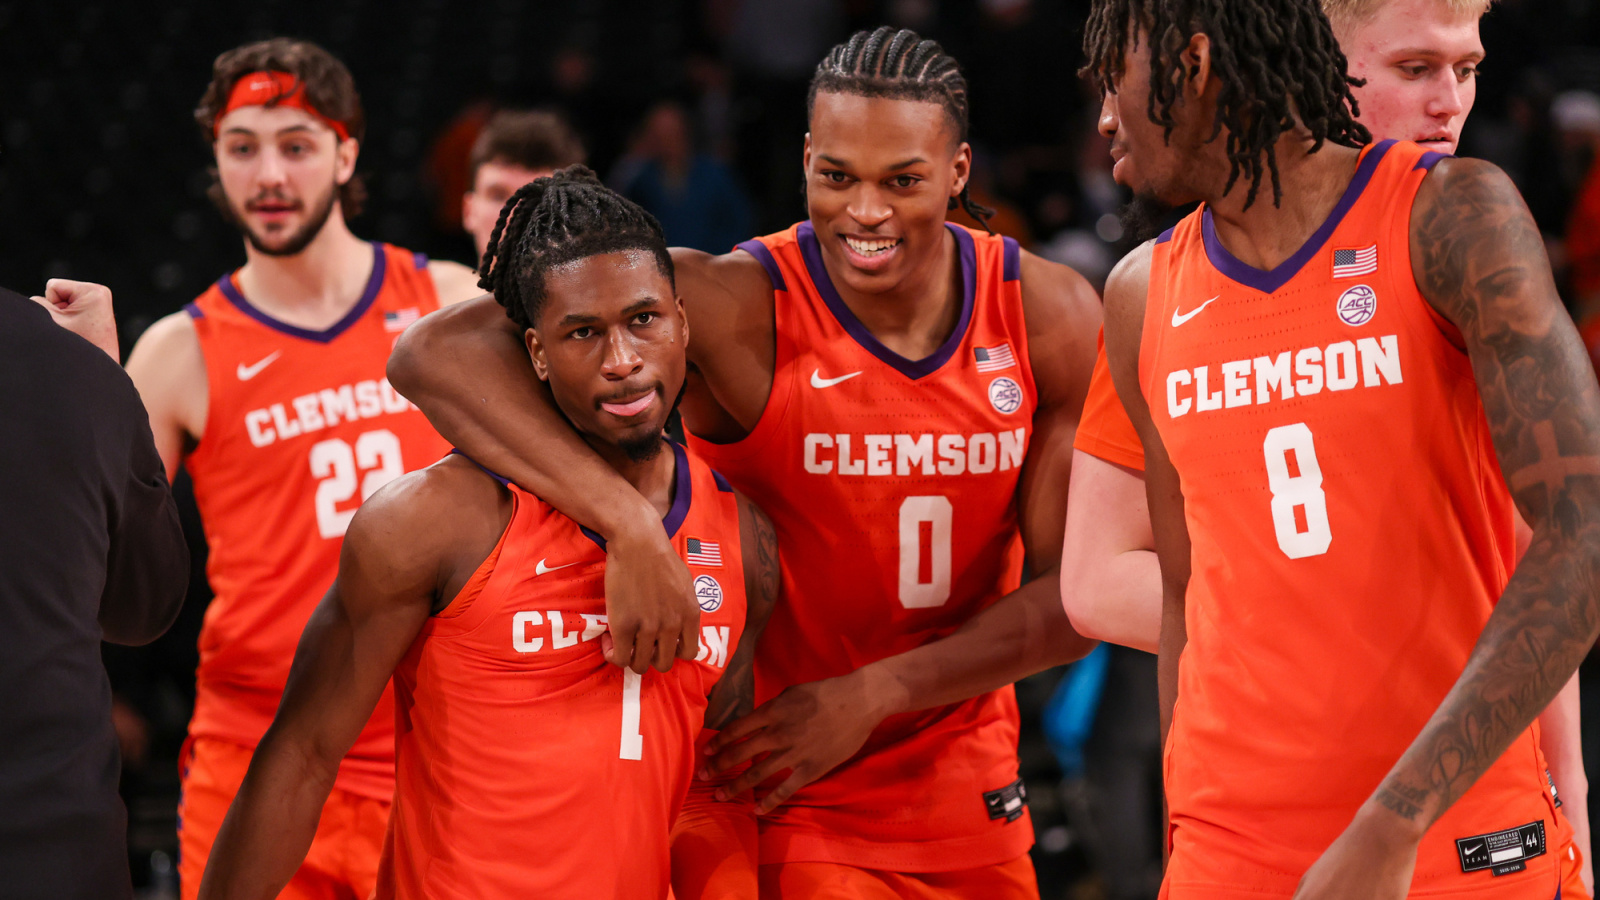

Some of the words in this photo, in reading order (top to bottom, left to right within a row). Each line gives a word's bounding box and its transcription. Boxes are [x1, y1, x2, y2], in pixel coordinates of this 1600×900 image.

[1344, 296, 1373, 308] ACC
[996, 388, 1017, 398] ACC
[1166, 334, 1404, 418] CLEMSON
[245, 377, 420, 448] CLEMSO
[804, 427, 1025, 476] CLEMSON
[309, 428, 405, 540] 22
[1263, 422, 1333, 560] 8
[898, 495, 953, 609] 0
[697, 587, 719, 596] ACC
[512, 610, 730, 668] CLEN
[619, 665, 643, 761] 1
[1466, 855, 1488, 864] TEAM
[1525, 832, 1538, 848] 44
